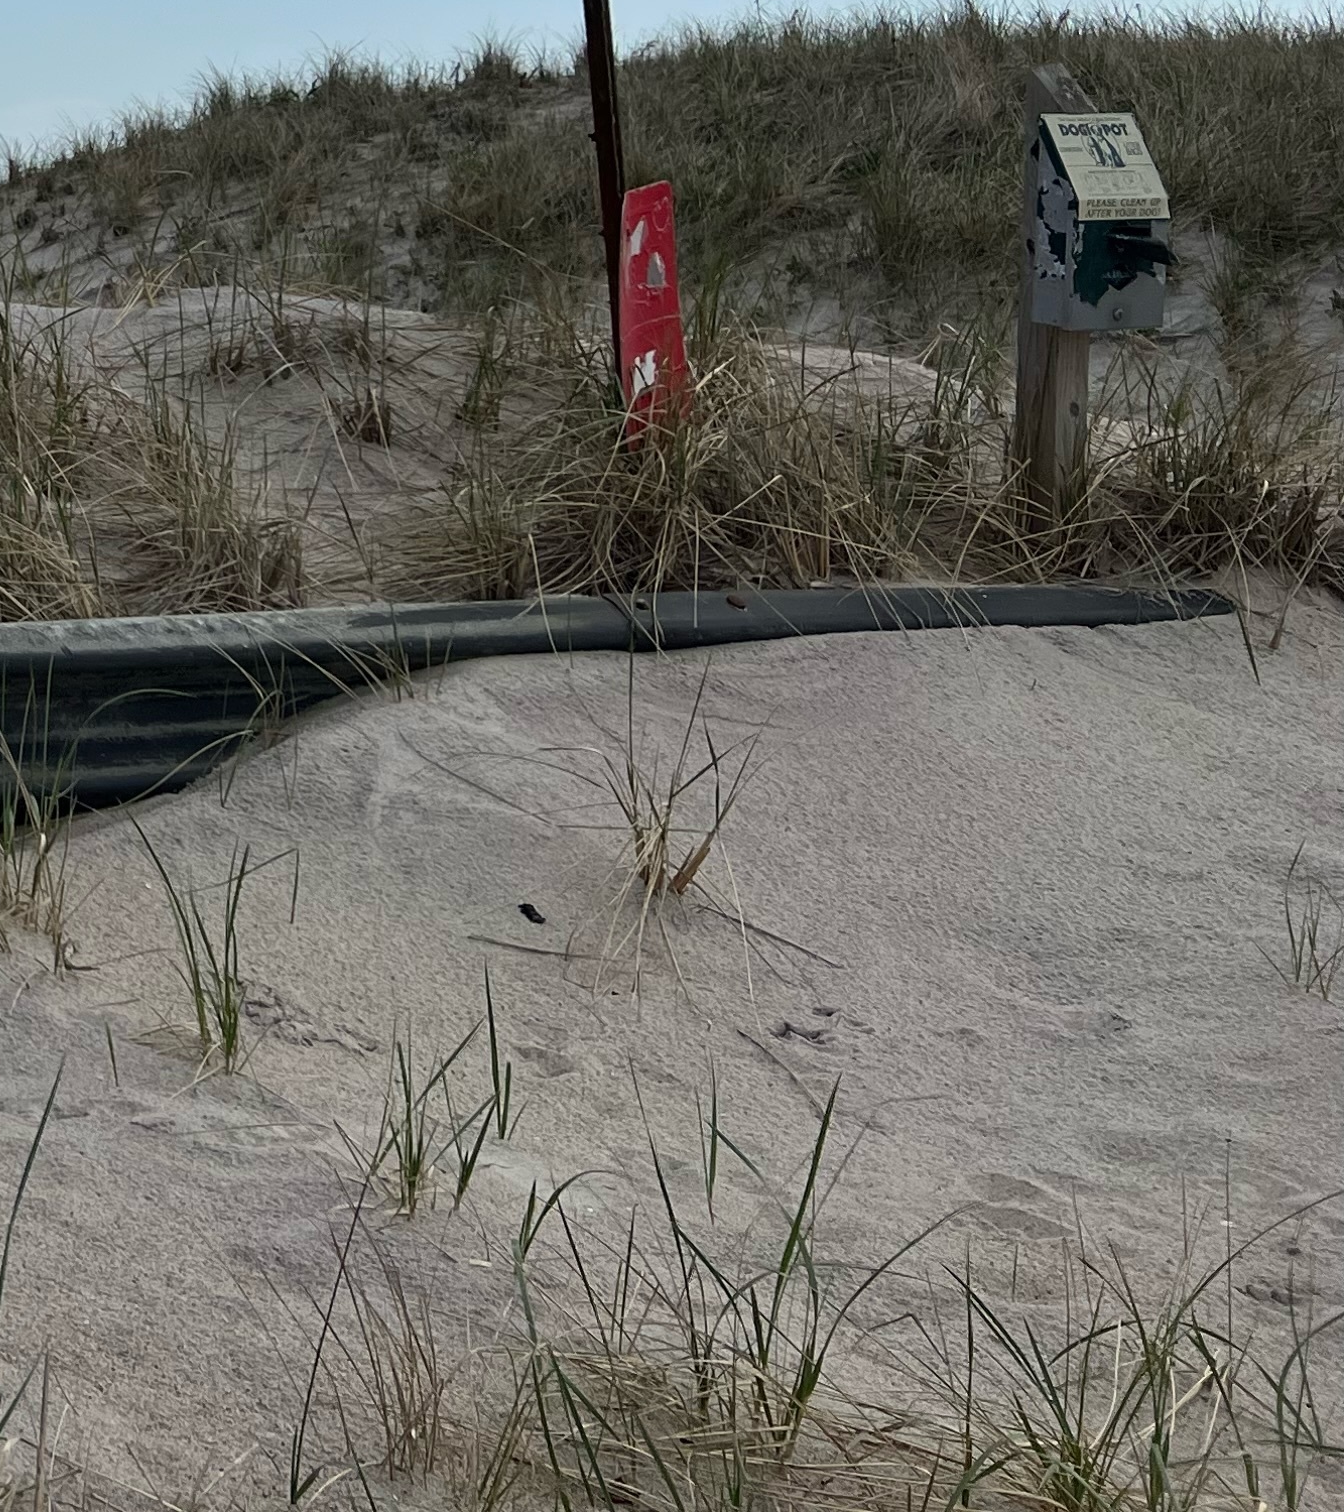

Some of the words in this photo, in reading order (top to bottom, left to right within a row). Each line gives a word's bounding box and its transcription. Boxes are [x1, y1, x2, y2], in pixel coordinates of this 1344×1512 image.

[1087, 198, 1117, 207] PLEASE
[1120, 198, 1147, 207] CLEAN
[1085, 209, 1112, 218] AFTER
[1115, 208, 1137, 217] YOUR
